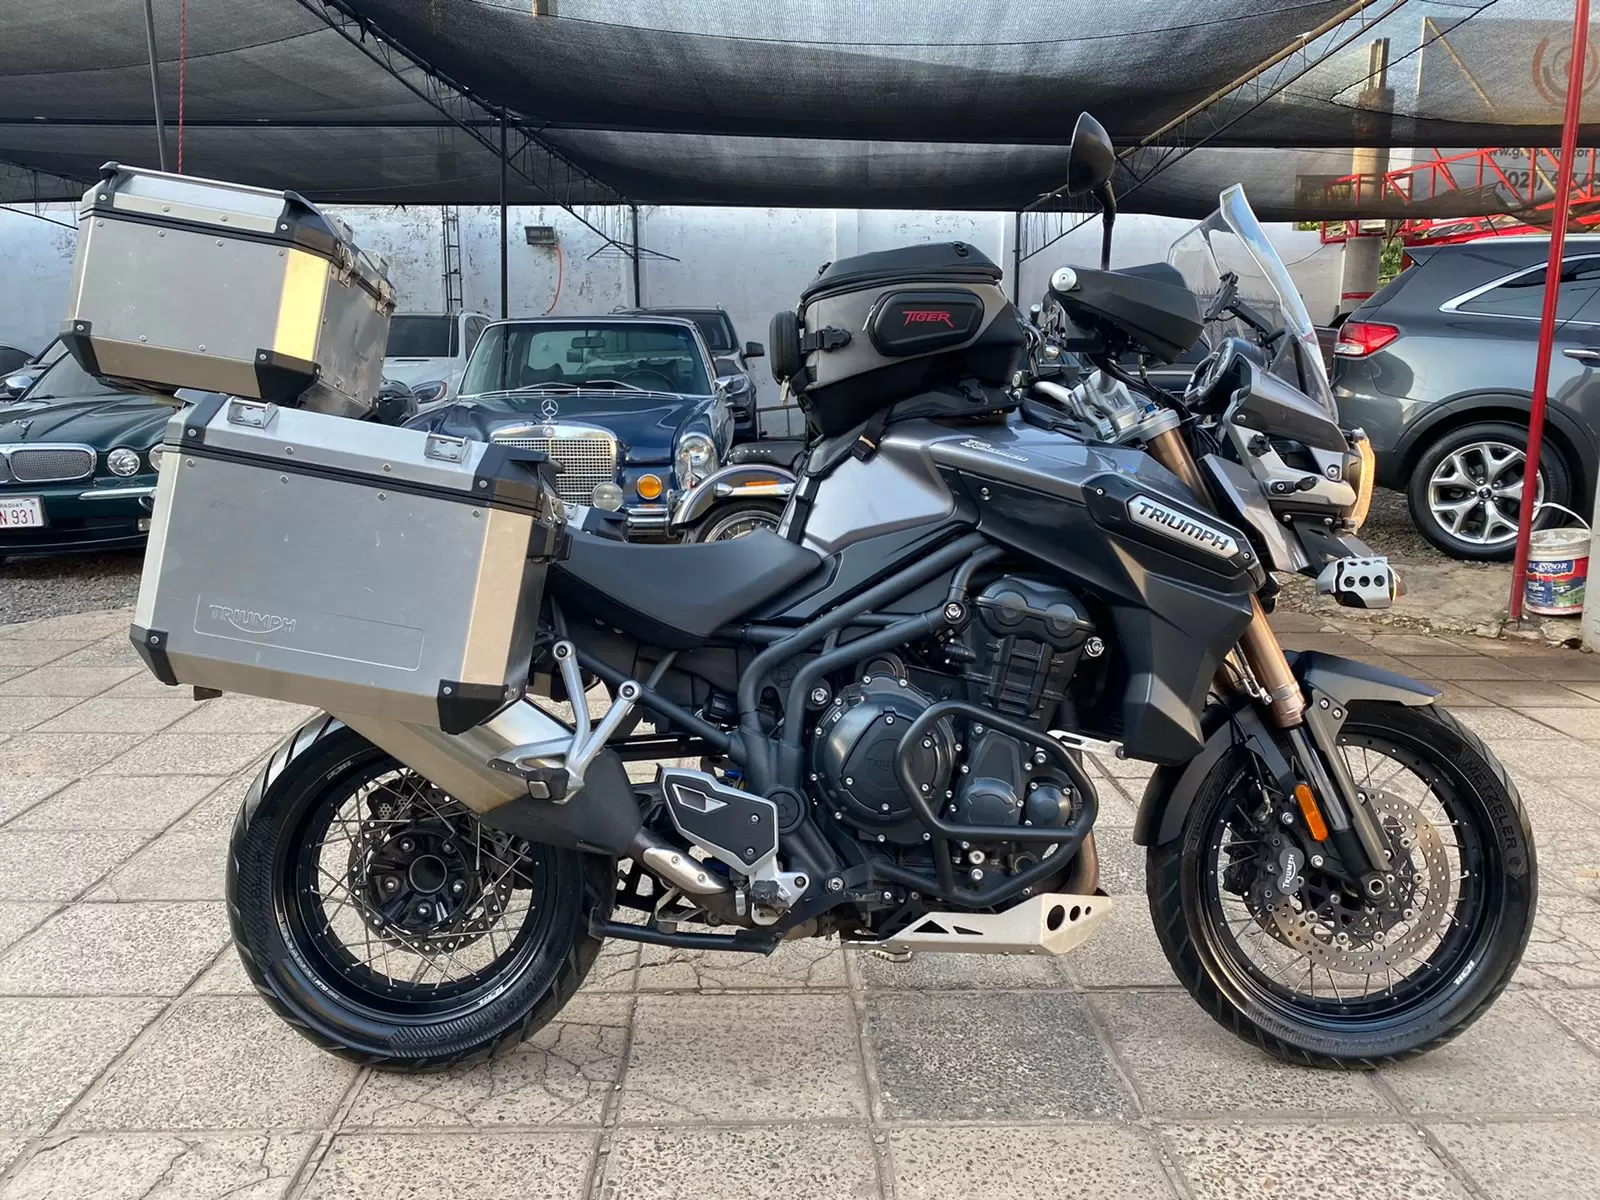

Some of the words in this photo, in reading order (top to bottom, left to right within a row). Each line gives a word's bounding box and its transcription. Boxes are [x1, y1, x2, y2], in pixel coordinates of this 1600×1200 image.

[902, 310, 954, 328] TIGER
[11, 509, 35, 525] 931
[1140, 502, 1230, 551] TRIUMPH
[209, 605, 296, 634] TRIUMPH
[1462, 759, 1518, 850] METZELER
[1282, 854, 1296, 888] TRIUMPH
